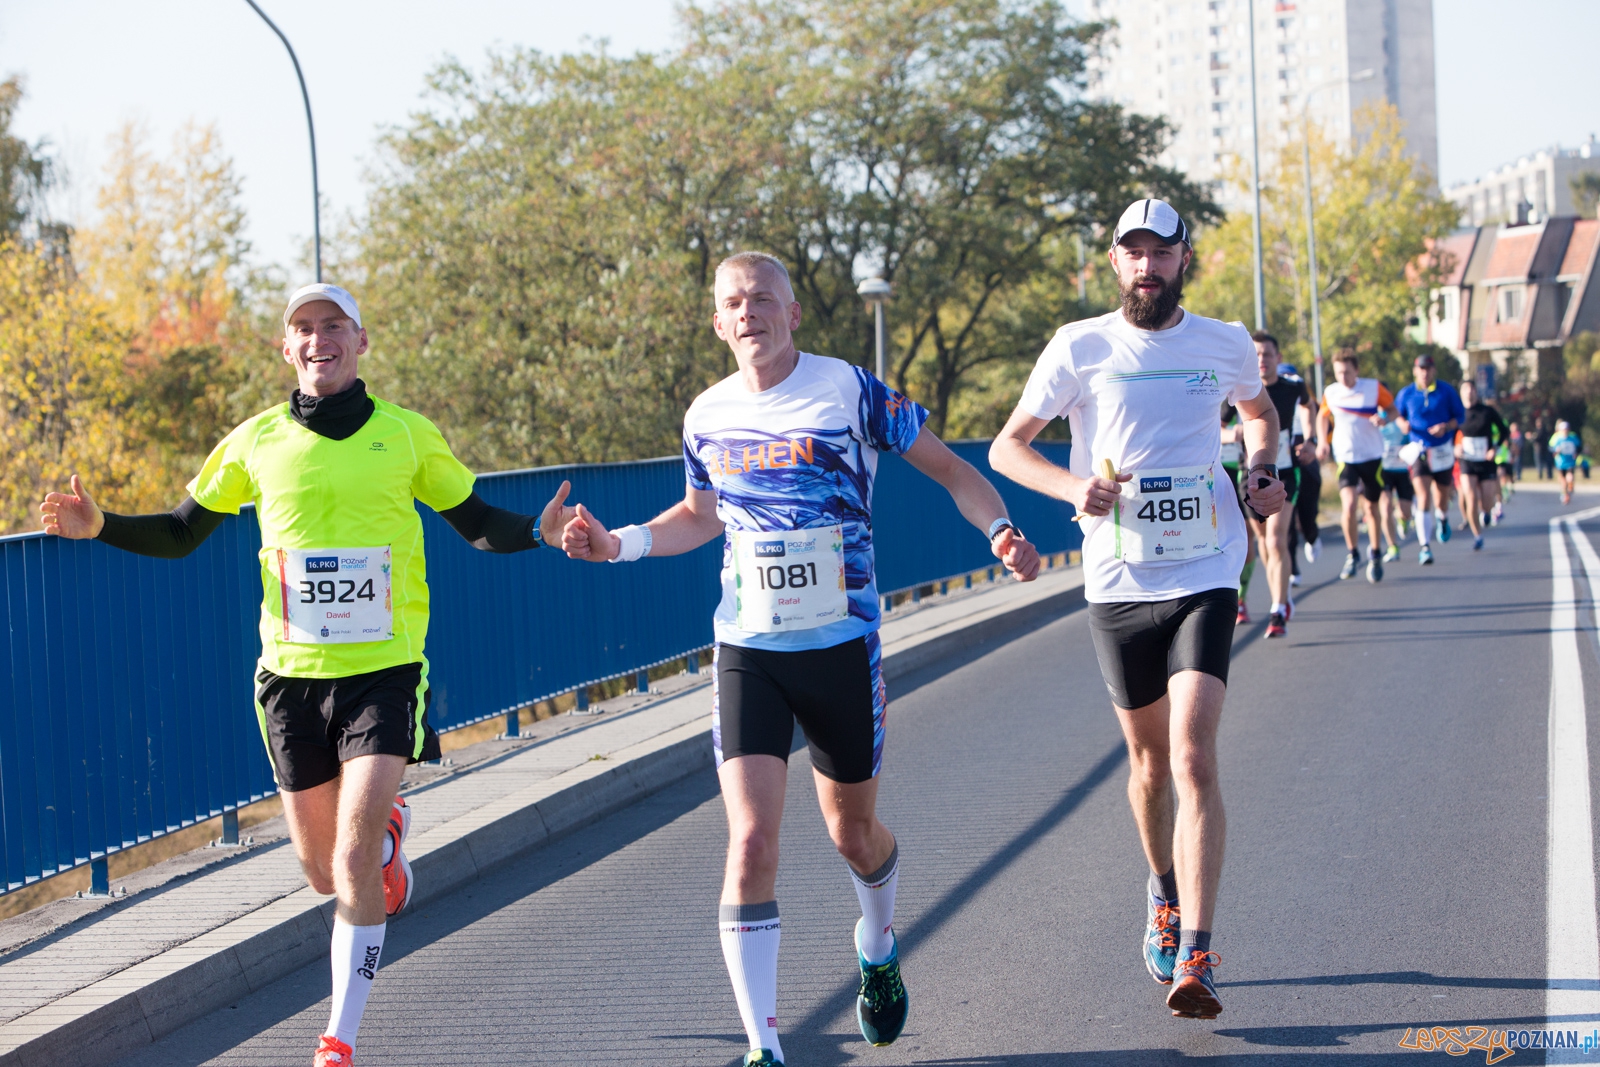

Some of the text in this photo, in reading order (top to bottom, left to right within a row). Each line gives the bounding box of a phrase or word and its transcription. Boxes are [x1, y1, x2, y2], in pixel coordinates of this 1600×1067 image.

[709, 437, 814, 477] ALHEN
[1137, 497, 1200, 522] 4861
[756, 544, 782, 553] 16. PKO
[308, 560, 336, 569] 16. PKO
[757, 562, 817, 590] 1081
[300, 578, 375, 604] 3924
